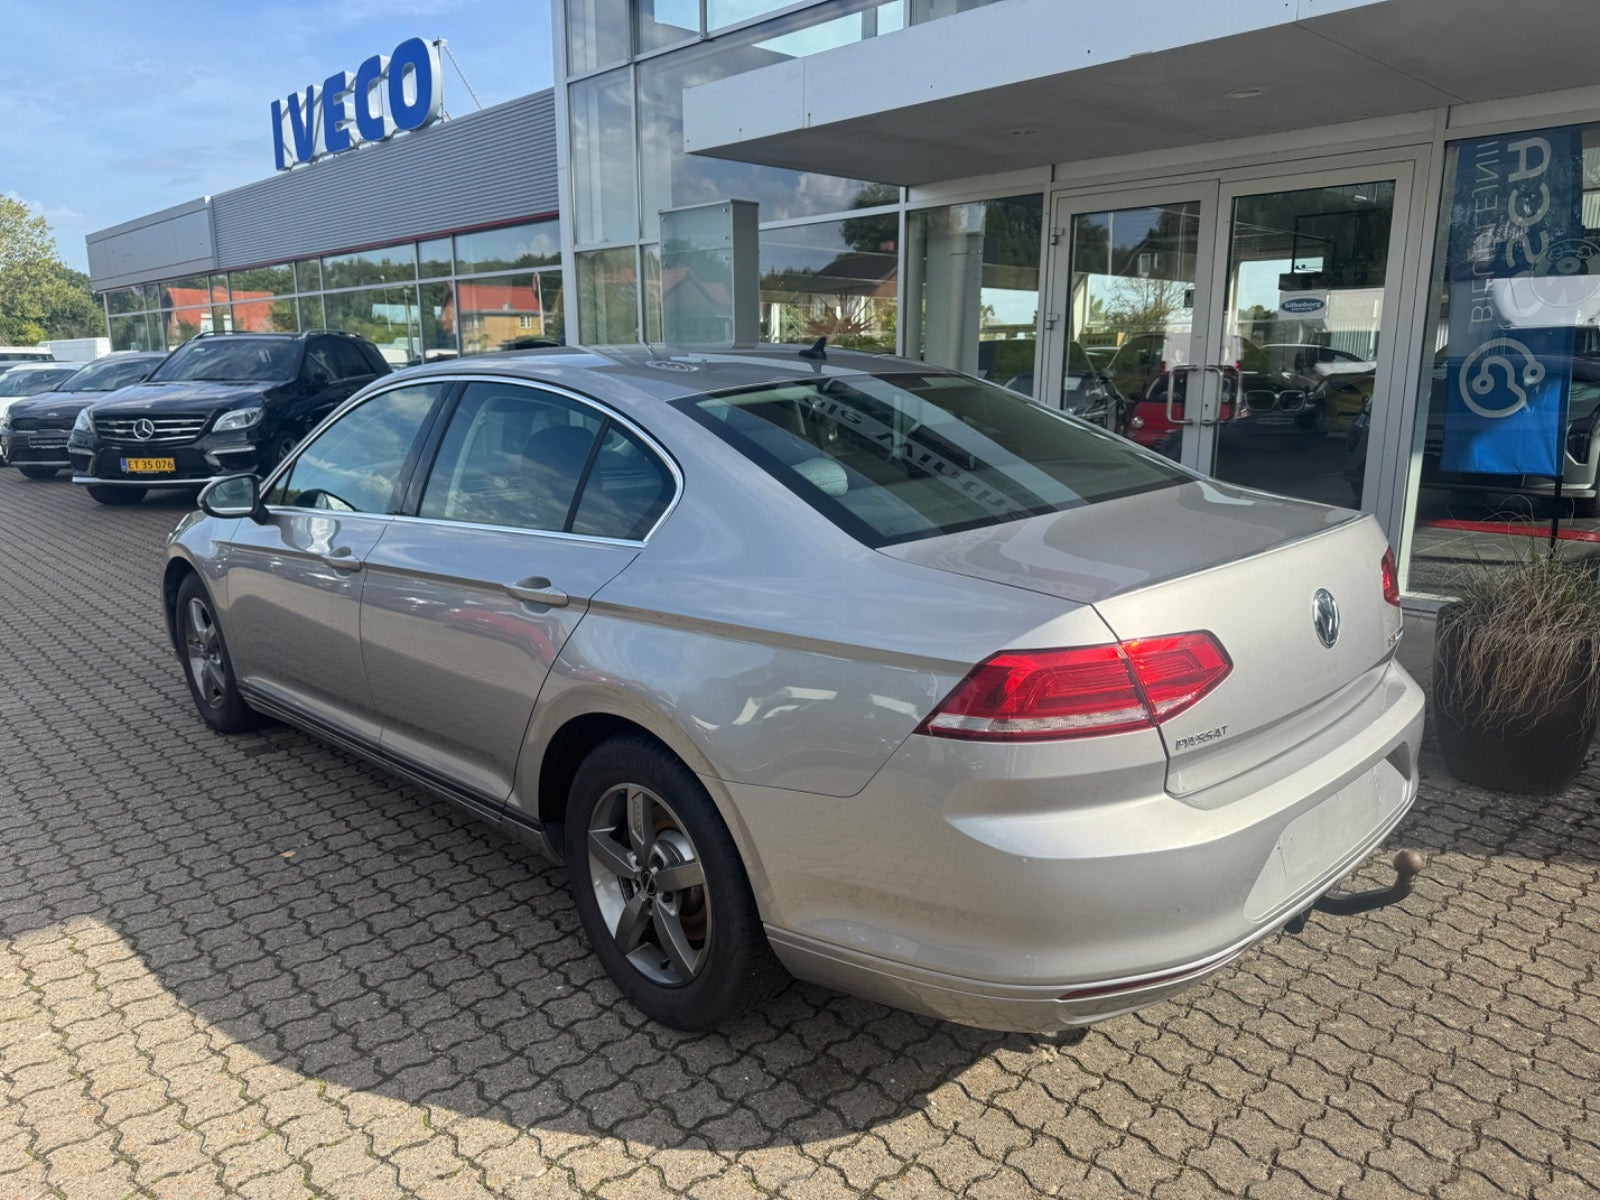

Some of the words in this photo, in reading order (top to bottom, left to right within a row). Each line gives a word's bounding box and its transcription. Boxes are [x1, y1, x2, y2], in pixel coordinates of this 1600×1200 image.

[271, 37, 436, 171] IVECO
[127, 460, 139, 470] ET
[143, 460, 153, 470] 35
[155, 460, 174, 470] 076
[1175, 725, 1228, 751] PASSAT
